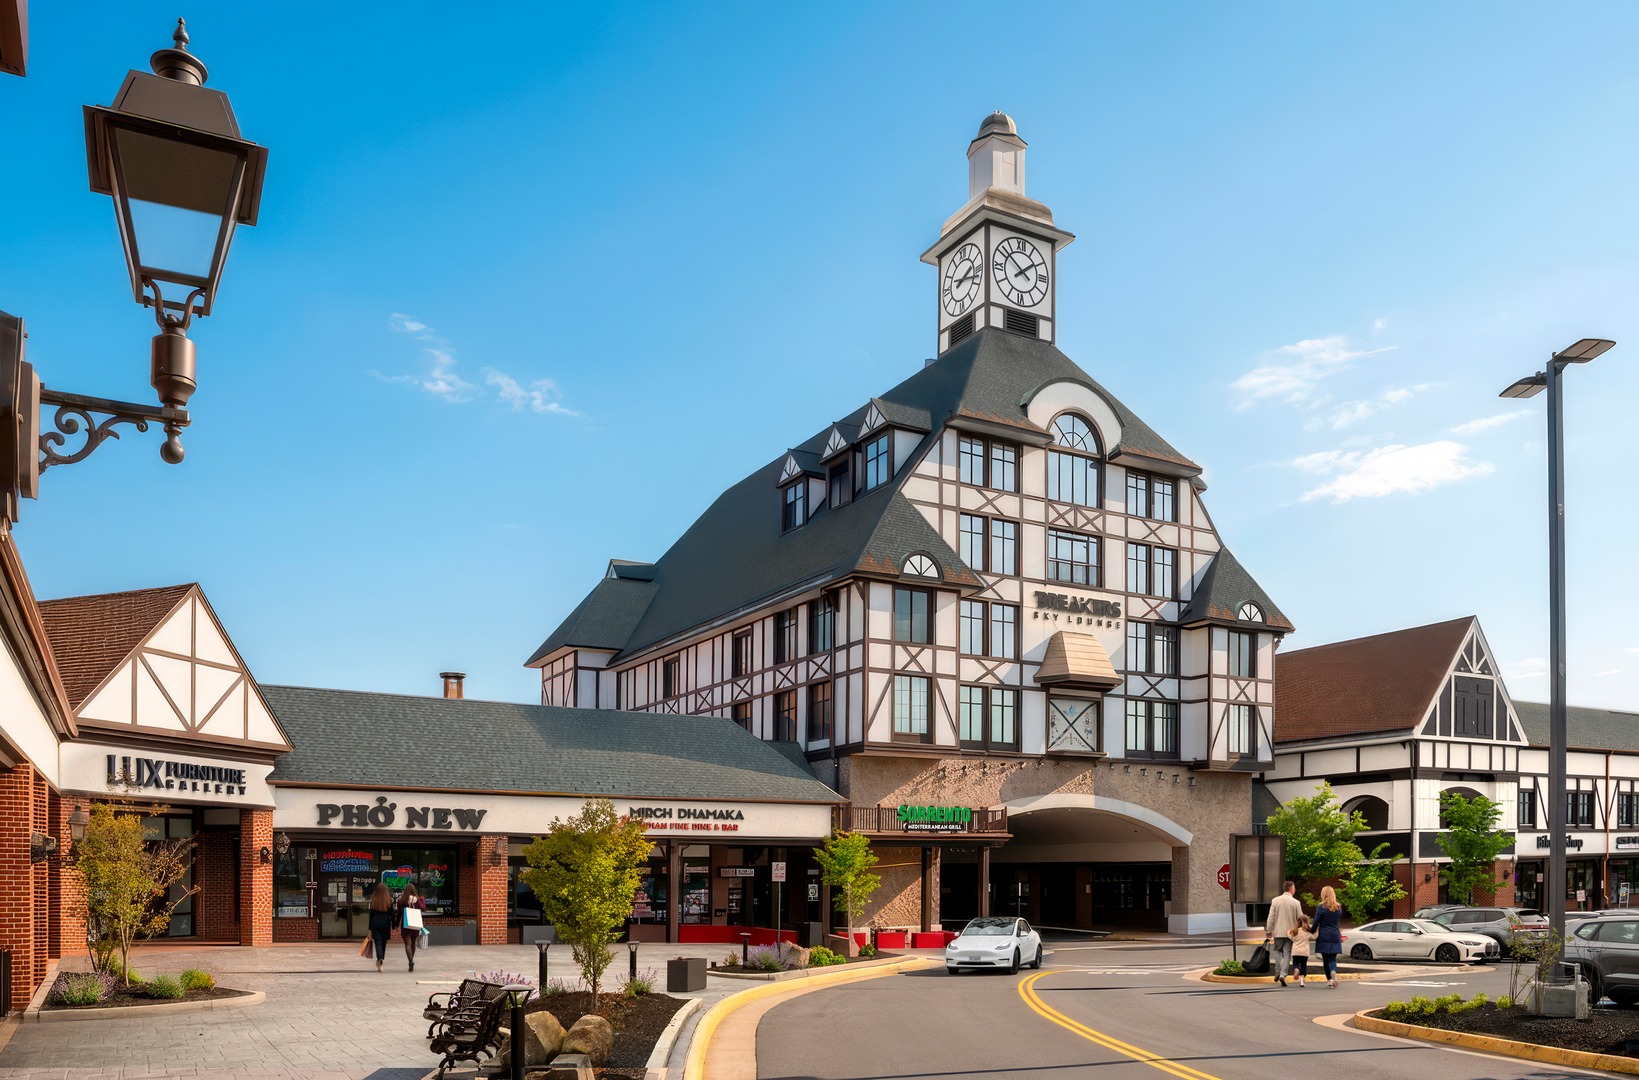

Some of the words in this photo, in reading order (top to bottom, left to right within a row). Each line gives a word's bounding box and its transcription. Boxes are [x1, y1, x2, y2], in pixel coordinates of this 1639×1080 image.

[1033, 590, 1121, 618] BREAKERS
[1033, 611, 1059, 621] SKY
[1068, 615, 1121, 629] LOUNGE
[106, 754, 165, 789] LUX
[166, 761, 246, 785] FURNITURE
[166, 778, 247, 796] GALLERY
[405, 806, 488, 830] NEW
[629, 806, 673, 819] MIRCH
[677, 808, 745, 820] DHAMAKA
[897, 805, 971, 823] SORRENTO
[669, 822, 690, 831] FINE
[691, 823, 712, 831] DINE
[713, 823, 720, 831] &
[721, 823, 739, 831] BAR
[1536, 834, 1550, 849] Bik
[1219, 872, 1230, 882] ST
